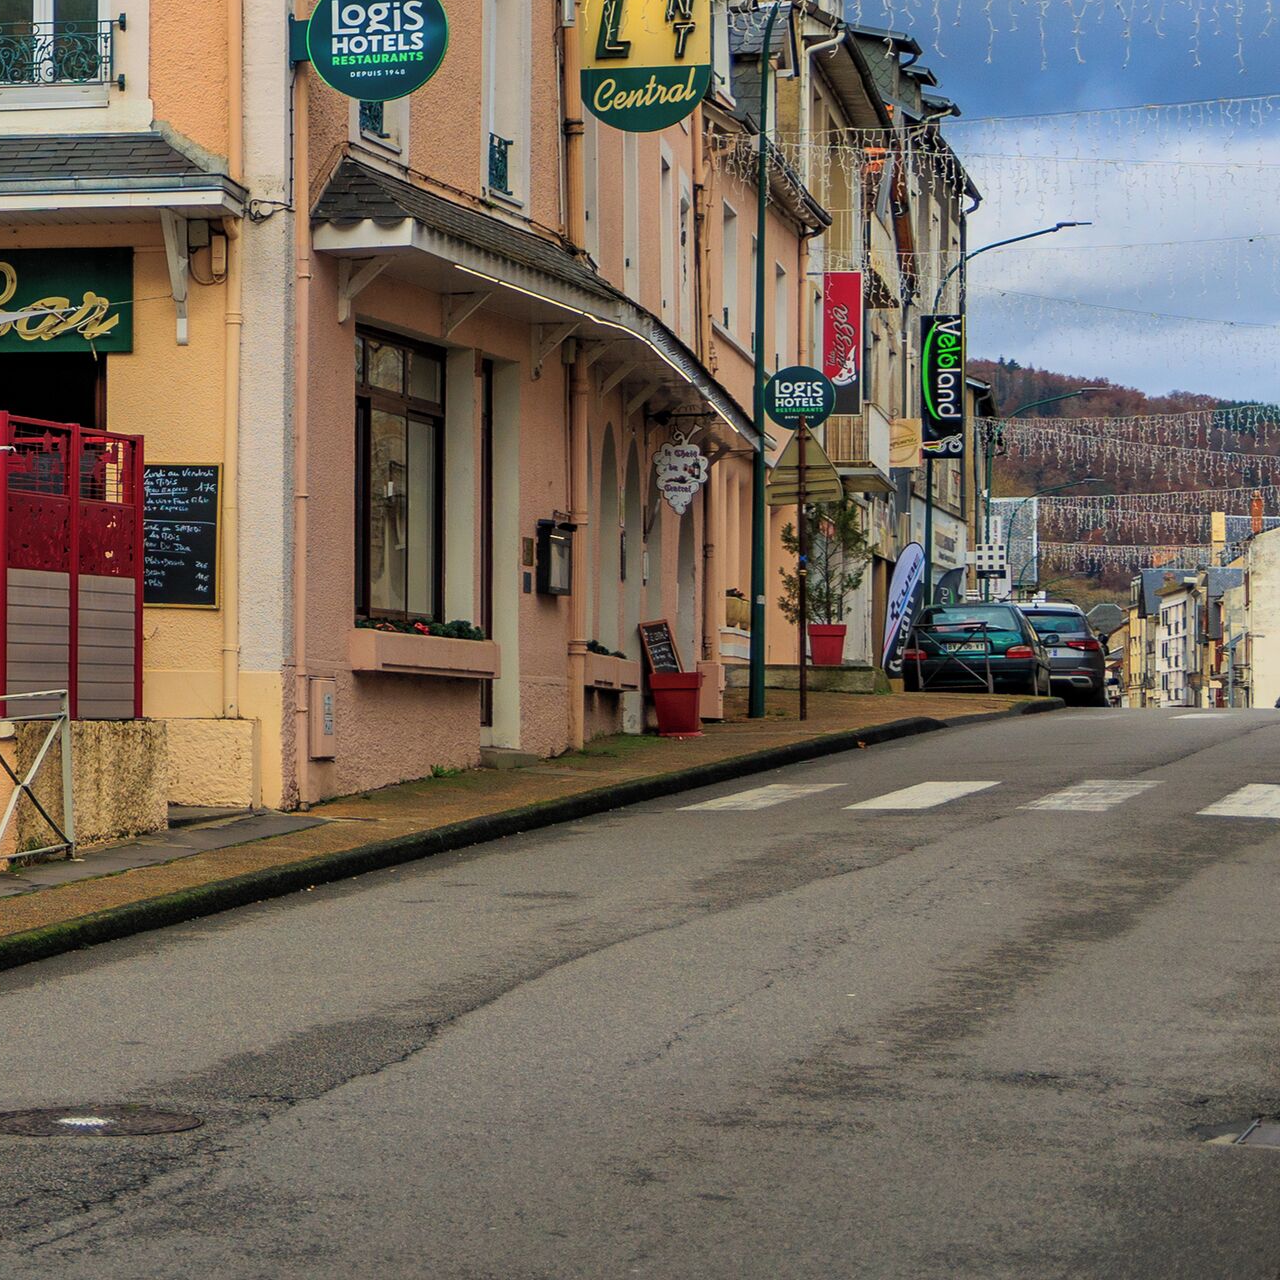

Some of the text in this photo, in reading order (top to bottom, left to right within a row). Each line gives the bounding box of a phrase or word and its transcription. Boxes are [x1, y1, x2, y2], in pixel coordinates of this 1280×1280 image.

[331, 32, 425, 55] HOTELS
[332, 51, 425, 66] RESTAURANTS
[350, 70, 382, 78] DEPUIS
[594, 67, 696, 112] Central
[775, 398, 824, 407] HOTELS
